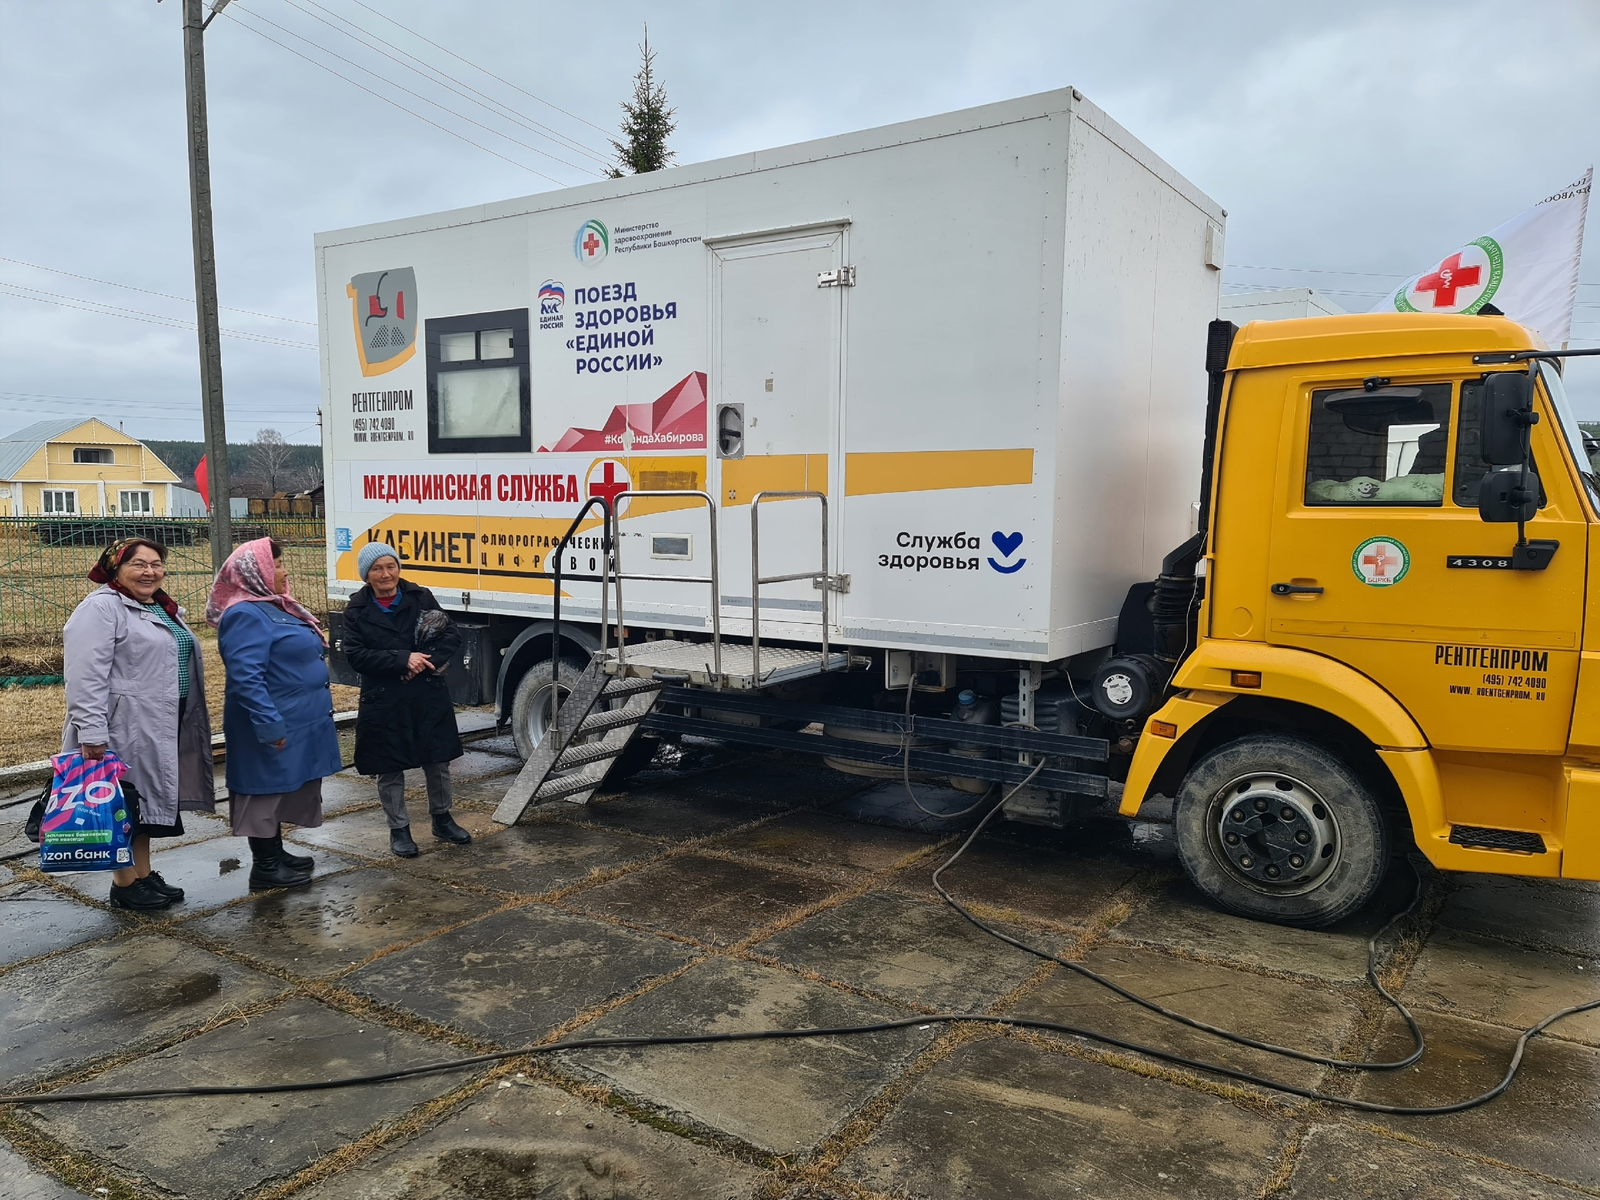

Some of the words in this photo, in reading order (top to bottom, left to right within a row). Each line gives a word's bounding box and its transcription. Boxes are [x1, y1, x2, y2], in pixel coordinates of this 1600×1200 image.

[614, 222, 660, 234] Министерство
[614, 230, 673, 245] здравоохранения
[614, 243, 652, 254] Республики
[653, 236, 702, 248] Башкортостан
[574, 282, 638, 305] ПОЕЗД
[539, 314, 564, 323] ЕДИНАЯ
[574, 302, 677, 330] ЗДОРОВЬЯ
[539, 322, 564, 330] РОССИЯ
[566, 324, 654, 353] «ЕДИНОЙ
[576, 353, 663, 374] РОССИИ»
[352, 389, 413, 413] РЕНТГЕНПРОМ
[353, 418, 367, 431] (495)
[369, 418, 379, 431] 742
[381, 417, 395, 431] 4090
[604, 431, 704, 445] #КоандаХабирова
[363, 474, 492, 504] МЕДИЦИНСКАЯ
[497, 474, 579, 503] СЛУЖБА
[481, 533, 615, 551] ФЛЮОРОГРАФЧЕСКЙ
[896, 531, 981, 552] Служба
[878, 554, 980, 572] здоровья
[1452, 559, 1508, 567] 4308
[1434, 645, 1549, 672] РЕНТГЕНПРОМ
[1482, 674, 1504, 686] (495)
[1507, 675, 1523, 687] 742
[1525, 677, 1547, 689] 4090
[1449, 685, 1473, 695] WWW.
[1536, 692, 1546, 701] RU
[75, 849, 110, 860] банк
